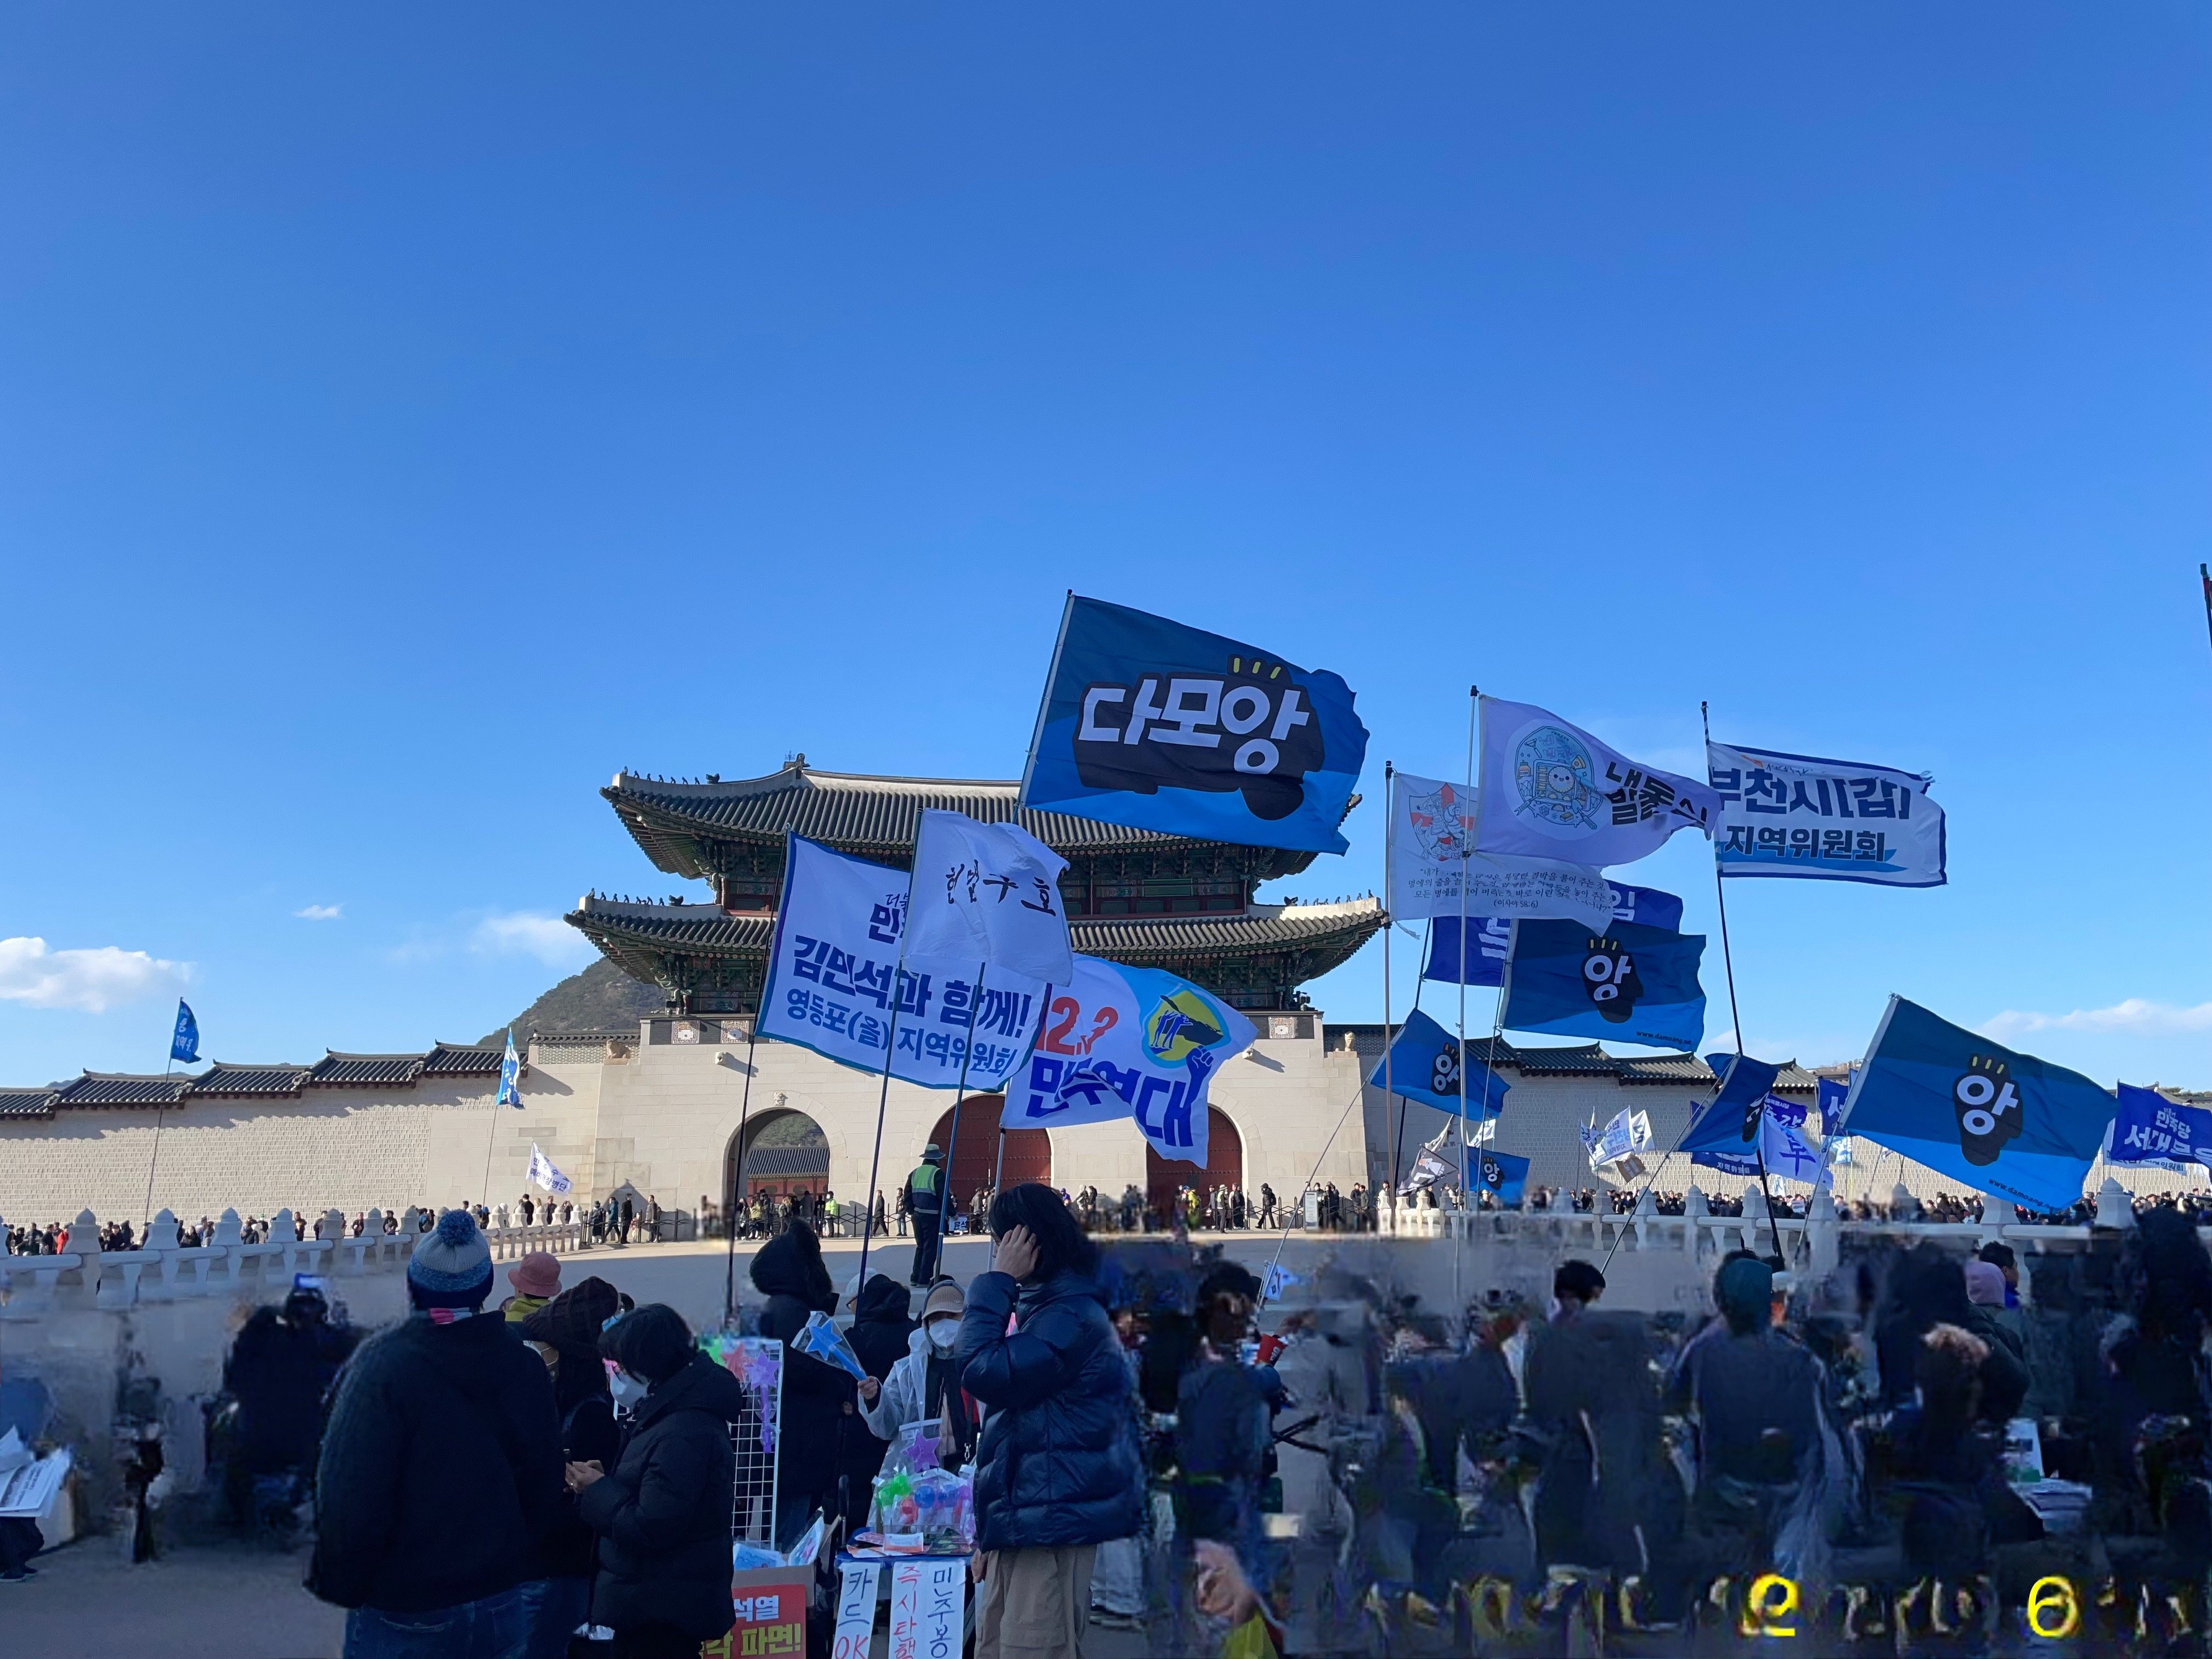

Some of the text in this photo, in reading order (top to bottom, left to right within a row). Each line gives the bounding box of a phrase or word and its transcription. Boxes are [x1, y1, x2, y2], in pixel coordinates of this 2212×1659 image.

[1078, 679, 1310, 775] 다모앙
[1724, 825, 1885, 862] 지역위원회
[1408, 878, 1432, 888] 멍에의
[1413, 889, 1431, 899] 모든
[1435, 888, 1458, 898] 멍에를
[1516, 889, 1532, 898] 바로
[1536, 888, 1553, 898] 이런
[1493, 899, 1538, 909] (이사야 58:6)
[793, 934, 1032, 1039] 김민석과 함께!
[1584, 955, 1632, 1001] 앙
[787, 988, 1018, 1078] 영등포(을) 지역위원회
[1434, 1054, 1460, 1091] 앙
[1956, 1075, 2018, 1135] 앙
[2155, 1110, 2191, 1139] 민주당
[1483, 1163, 1500, 1182] 앙
[838, 1568, 872, 1627] 카드
[927, 1566, 957, 1659] 민주봉
[741, 1622, 802, 1656] 파면!
[835, 1634, 868, 1659] OK
